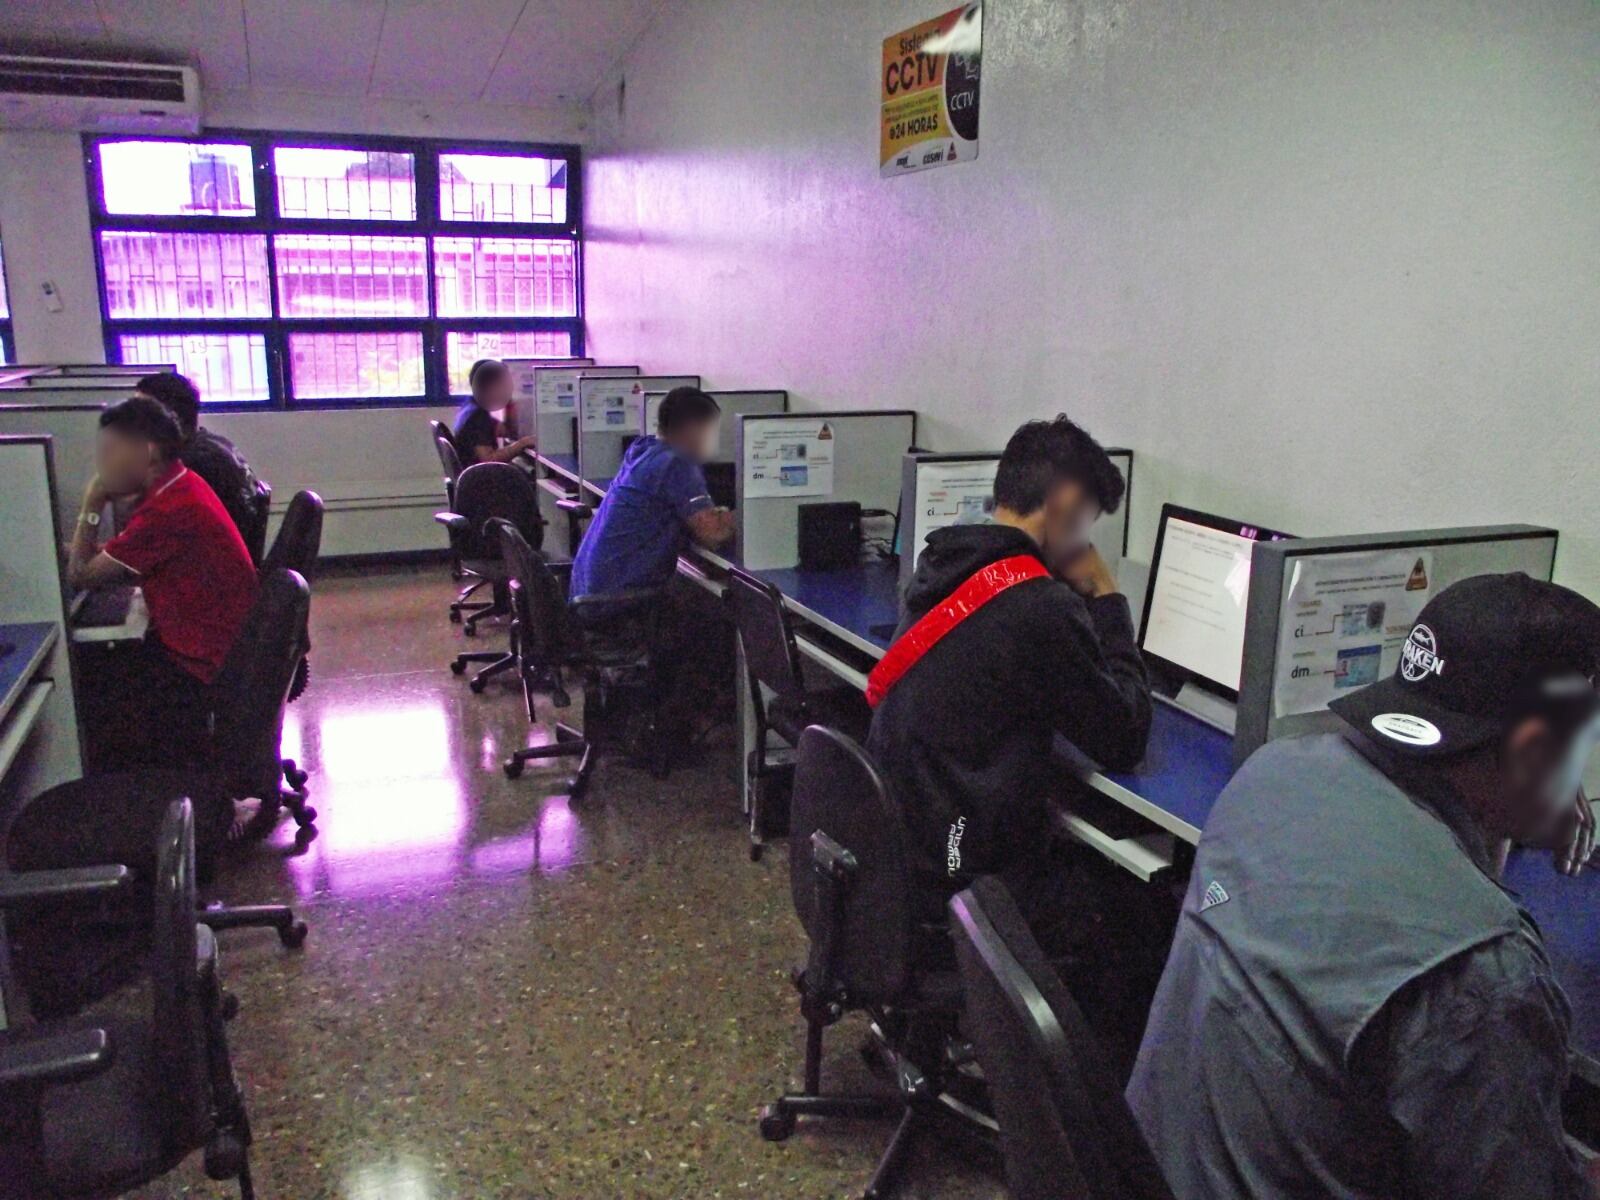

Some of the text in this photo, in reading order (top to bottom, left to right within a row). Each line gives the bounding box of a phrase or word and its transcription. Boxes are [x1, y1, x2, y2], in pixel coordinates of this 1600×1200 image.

[886, 51, 938, 95] CCTV
[950, 91, 975, 111] CCTV
[895, 113, 938, 140] 24 HORAS
[927, 507, 935, 517] ci
[1294, 624, 1304, 638] ci
[1291, 665, 1310, 679] dm
